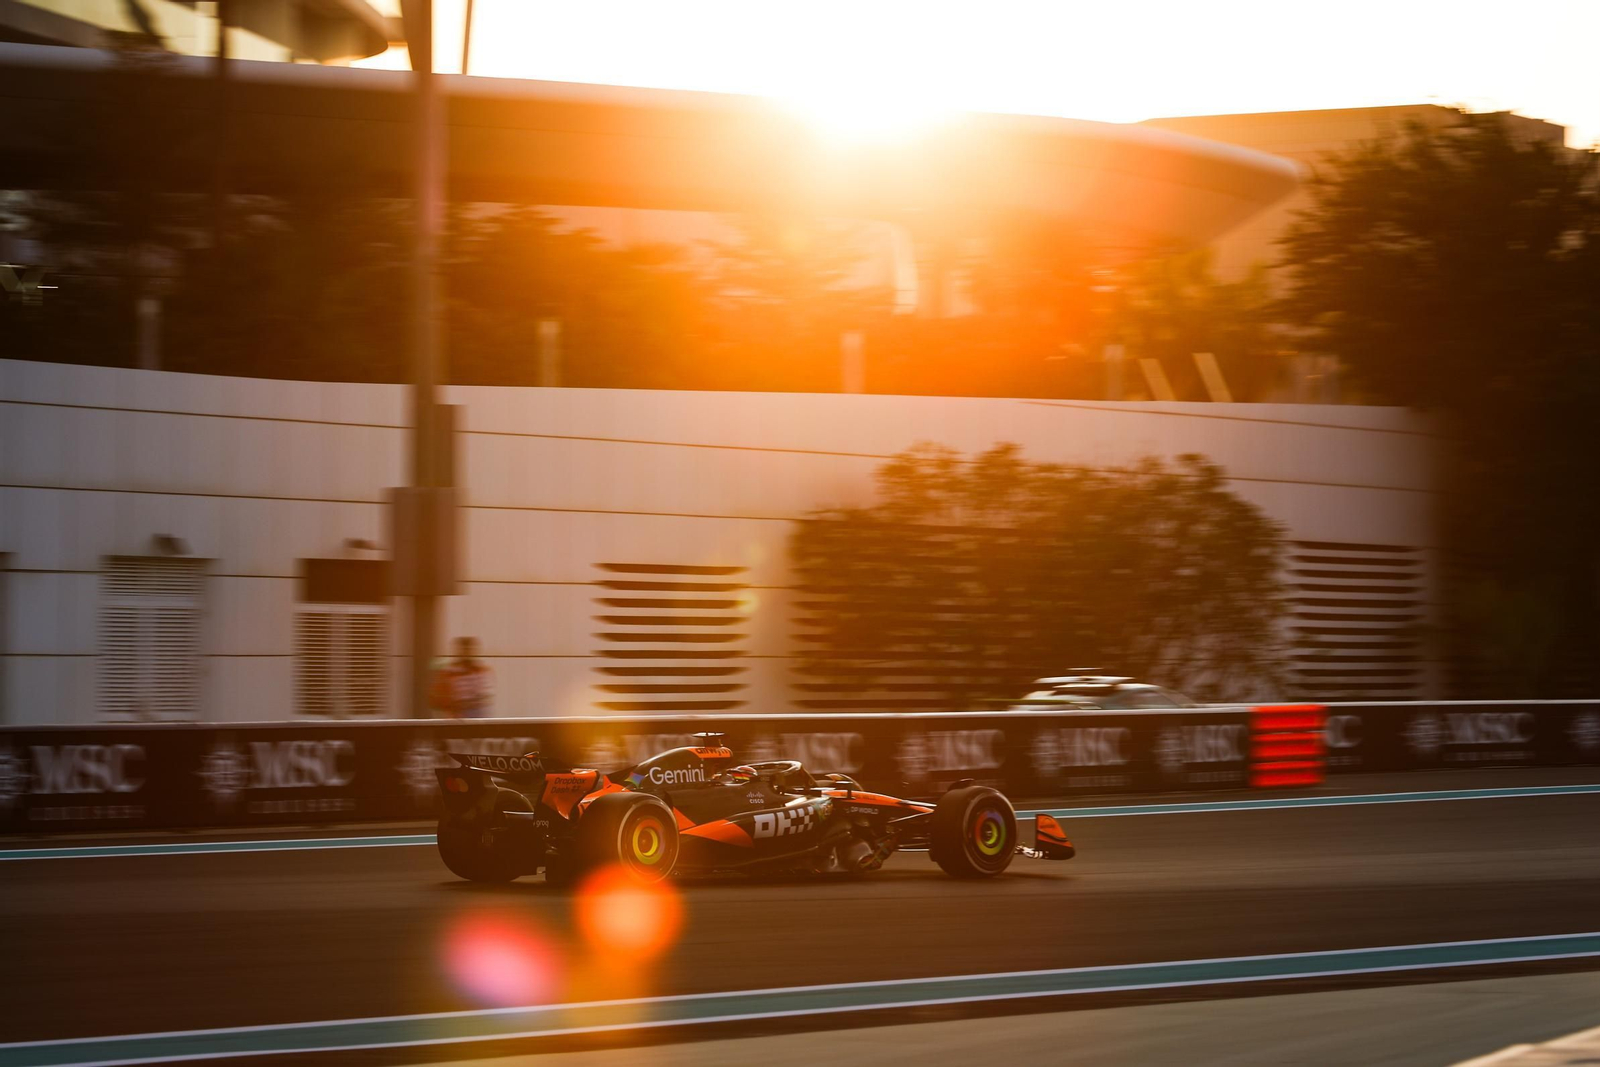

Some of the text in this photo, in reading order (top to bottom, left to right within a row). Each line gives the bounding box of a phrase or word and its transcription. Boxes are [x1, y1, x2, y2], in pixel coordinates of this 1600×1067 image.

[28, 744, 147, 794] MSC
[248, 740, 354, 789] MSC
[467, 755, 545, 772] VELO.COM
[649, 763, 705, 785] Gemini
[554, 776, 587, 785] Dropbox
